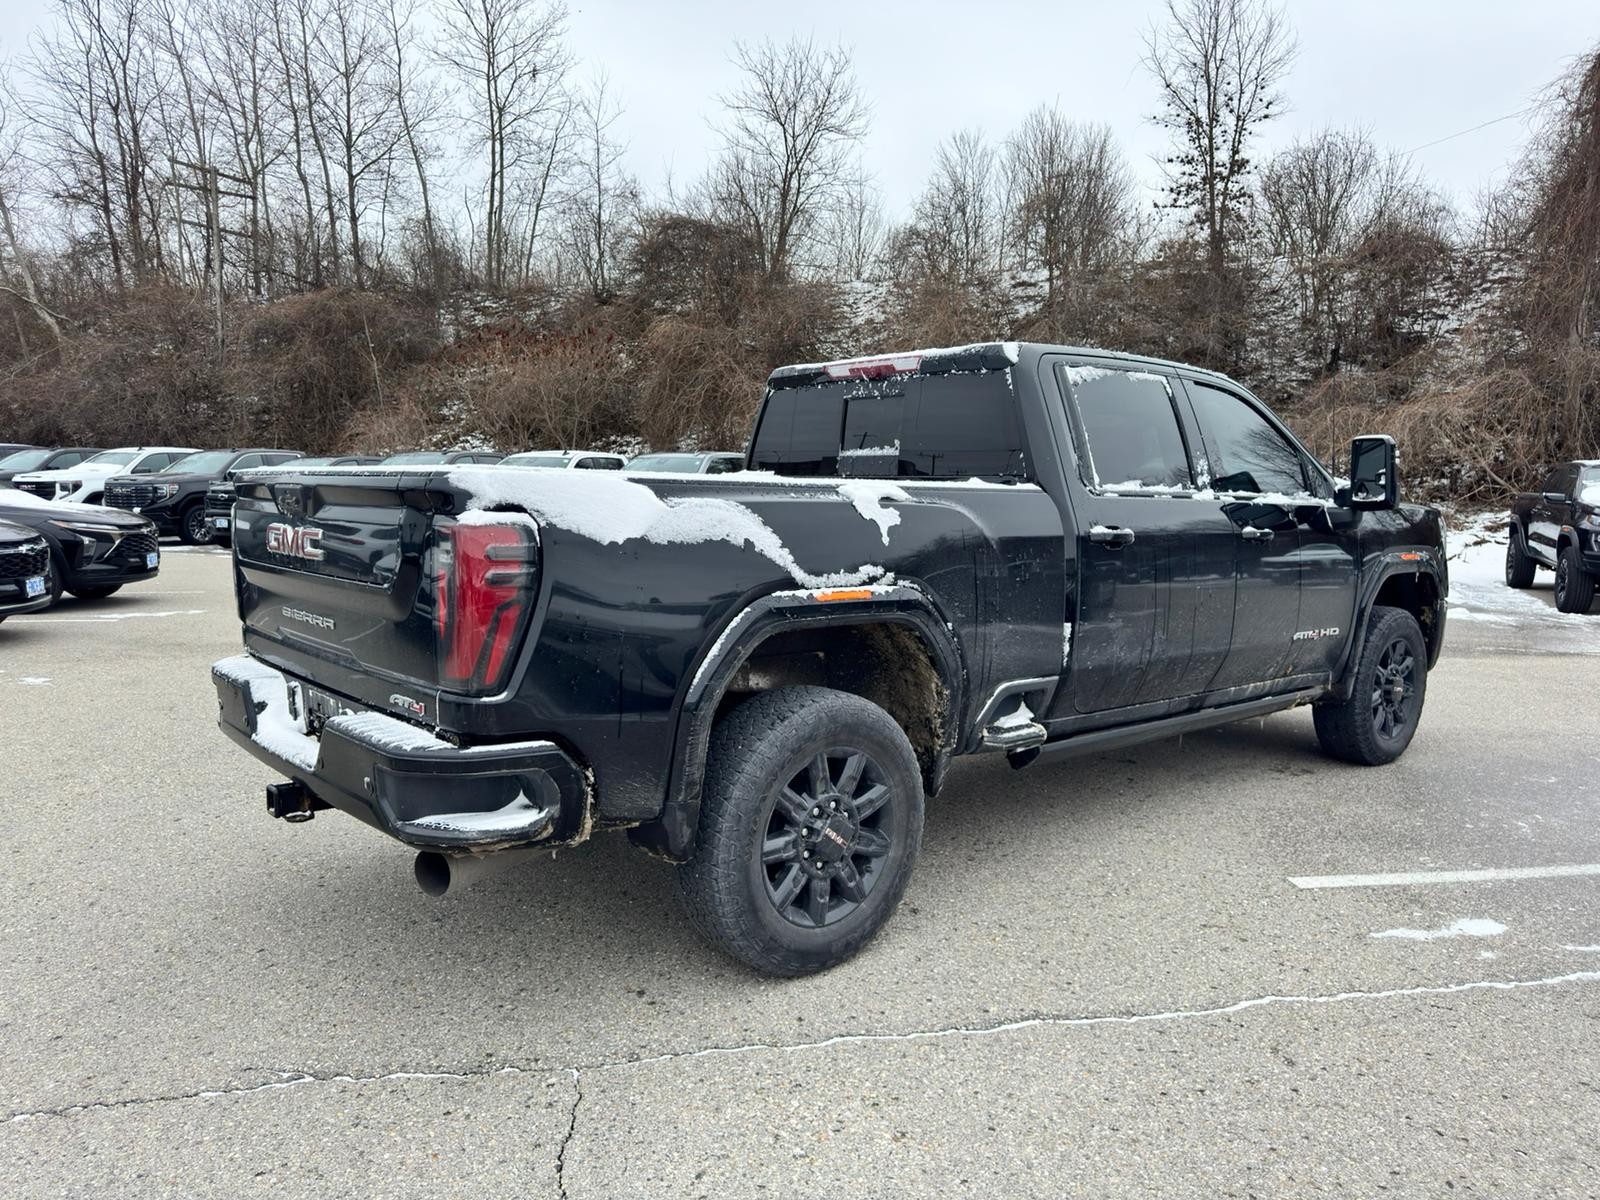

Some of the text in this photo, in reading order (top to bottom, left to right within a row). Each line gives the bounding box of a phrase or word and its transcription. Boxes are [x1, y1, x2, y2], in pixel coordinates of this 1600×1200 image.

[266, 522, 324, 561] GMC
[282, 606, 335, 630] SIERRA
[1293, 627, 1340, 641] AT4 HD
[389, 693, 425, 717] AT4
[825, 827, 848, 849] GMC
